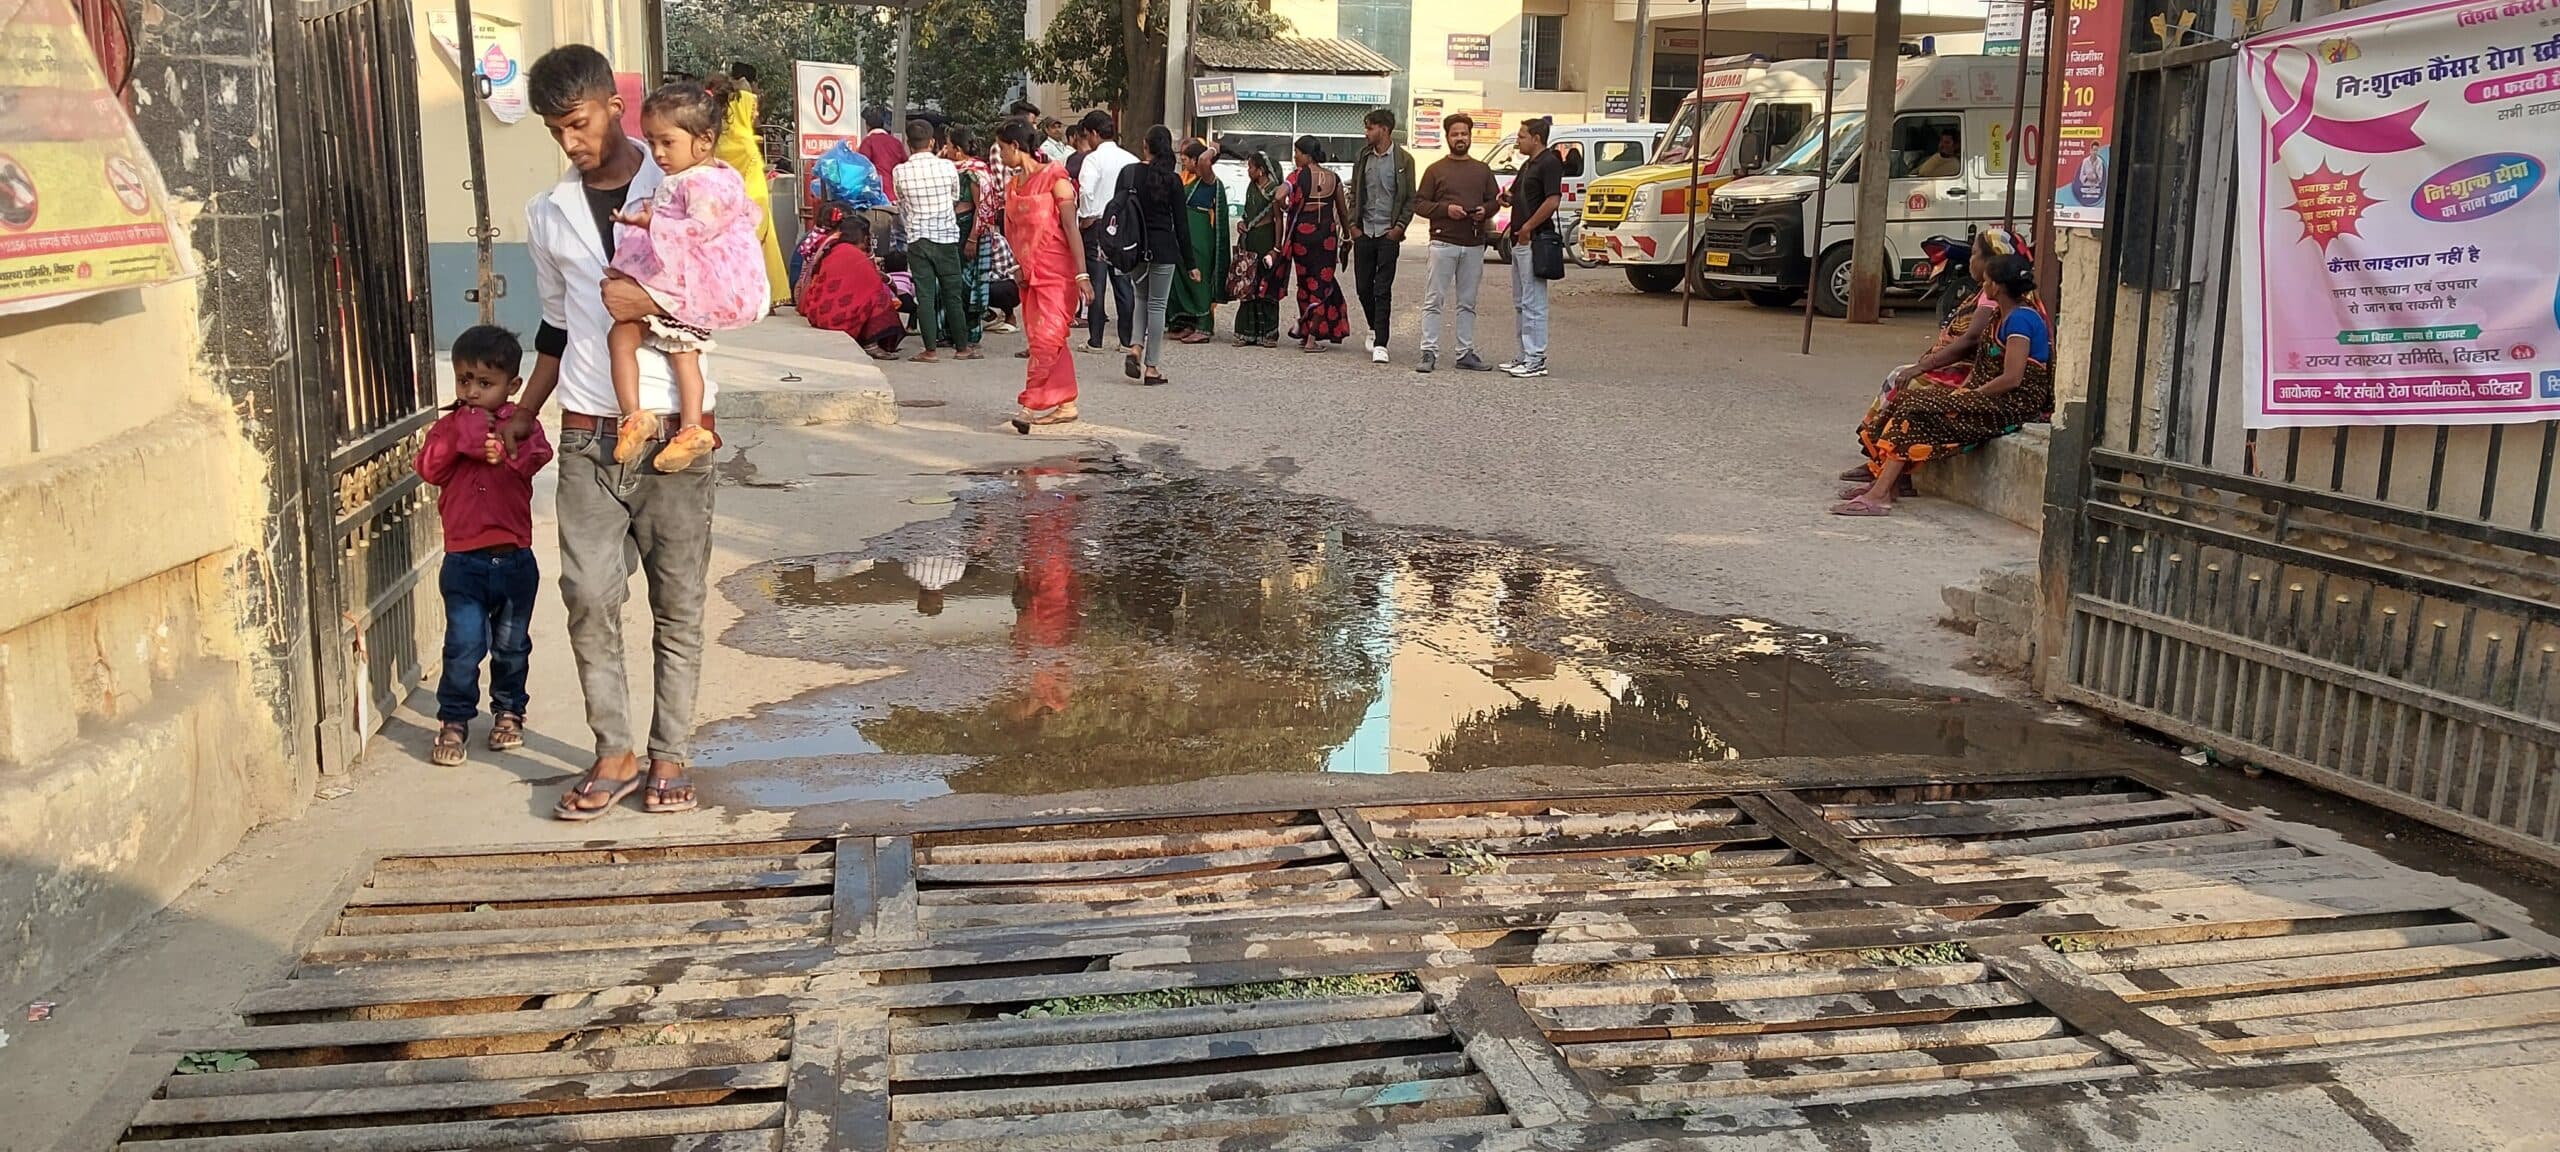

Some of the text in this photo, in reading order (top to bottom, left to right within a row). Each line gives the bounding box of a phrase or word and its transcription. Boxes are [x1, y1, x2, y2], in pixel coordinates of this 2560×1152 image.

[2428, 54, 2480, 82] कैंसर
[2487, 46, 2526, 71] रोग
[2483, 86, 2499, 99] 04
[2505, 72, 2547, 94] फरवरी
[2075, 86, 2094, 106] 10
[2498, 103, 2523, 120] सभी
[805, 139, 817, 150] NO
[2495, 162, 2528, 184] सेवा
[2333, 179, 2348, 191] की
[2345, 192, 2357, 203] के
[2441, 205, 2457, 217] का
[2460, 196, 2486, 213] लाभ
[2327, 245, 2481, 273] कैंसर लाइलाज नहीं है
[2360, 286, 2374, 297] पर
[2374, 284, 2410, 297] पहचान
[2414, 279, 2432, 295] एवं
[2436, 278, 2479, 292] उपचार
[2363, 302, 2386, 314] जान
[2406, 296, 2443, 311] सकती
[2447, 294, 2457, 309] है
[2305, 347, 2500, 368] राज्य स्वास्थ्य समिति, बिहार
[2280, 383, 2322, 399] आयोजक
[2334, 381, 2351, 399] गैर
[2354, 380, 2385, 399] संचारी
[2389, 381, 2410, 398] रोग
[2413, 379, 2475, 398] पदाधिकारी,
[2479, 379, 2523, 396] कटिहार
